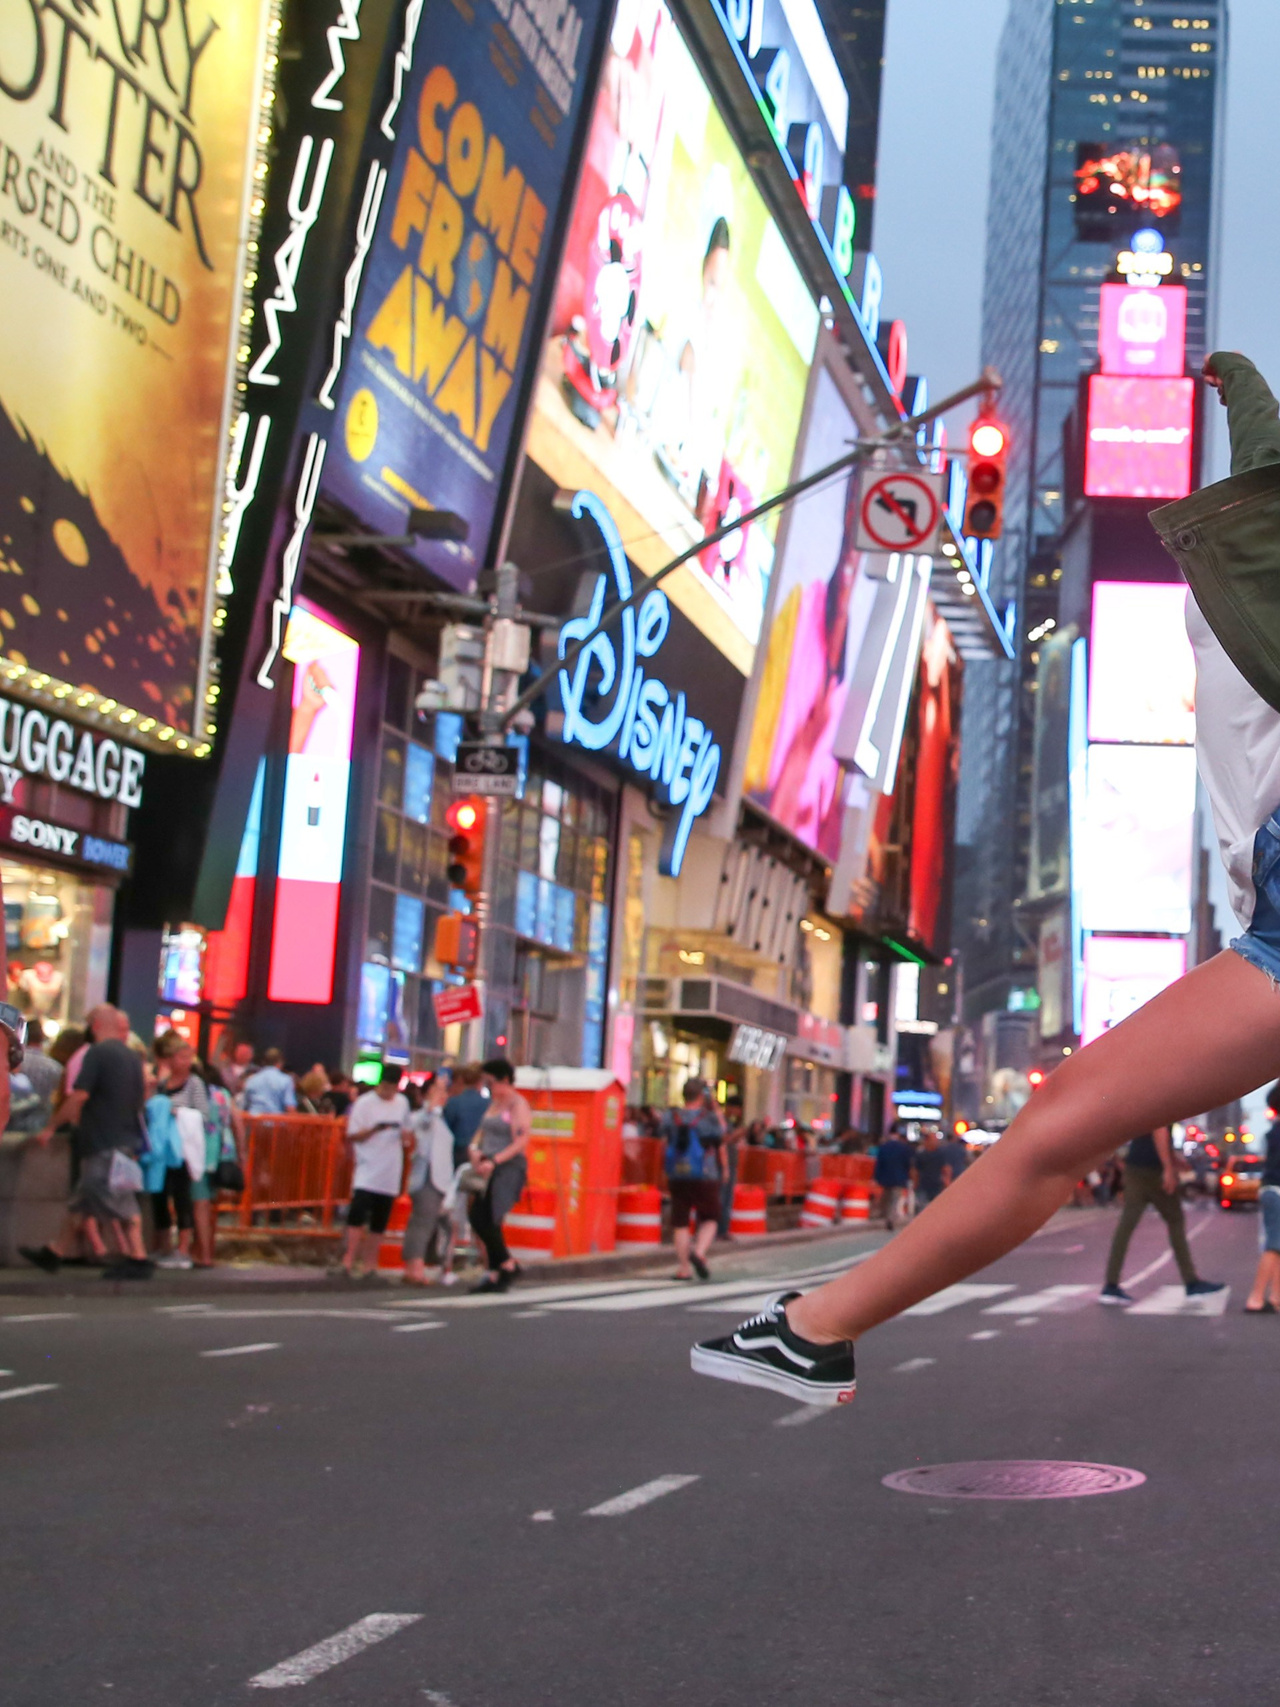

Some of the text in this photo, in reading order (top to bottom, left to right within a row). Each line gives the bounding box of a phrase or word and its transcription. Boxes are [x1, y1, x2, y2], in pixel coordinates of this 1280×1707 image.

[35, 140, 117, 225] AND THE
[417, 64, 548, 287] COME
[34, 246, 69, 288] ONE
[72, 275, 107, 317] AND
[111, 302, 148, 346] TWO
[91, 224, 182, 326] CHILD
[390, 146, 532, 376] FROM
[365, 262, 514, 454] AWAY
[0, 695, 146, 808] UGGAGE
[10, 814, 79, 856] SONY
